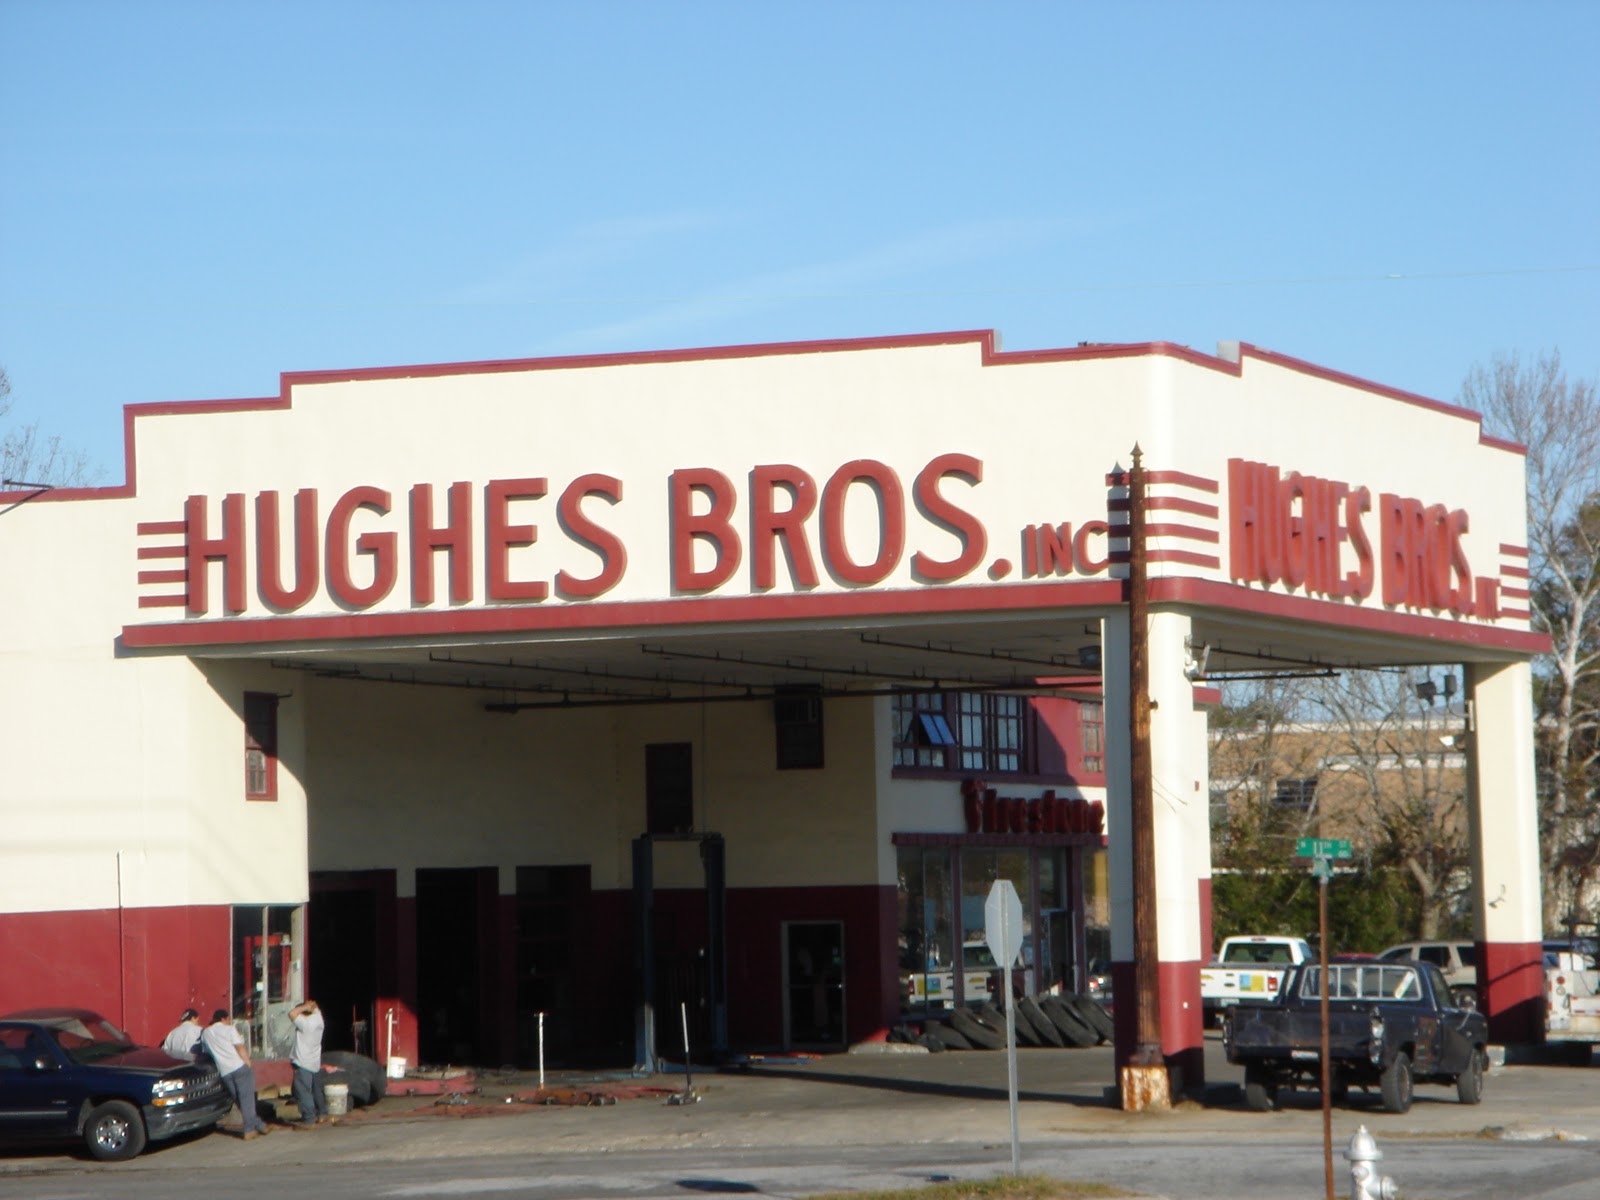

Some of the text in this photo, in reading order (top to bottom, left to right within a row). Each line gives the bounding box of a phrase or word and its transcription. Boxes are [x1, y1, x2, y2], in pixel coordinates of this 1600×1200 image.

[185, 453, 1110, 617] HUGHES BROS. INC
[1227, 457, 1374, 604] HUGHES
